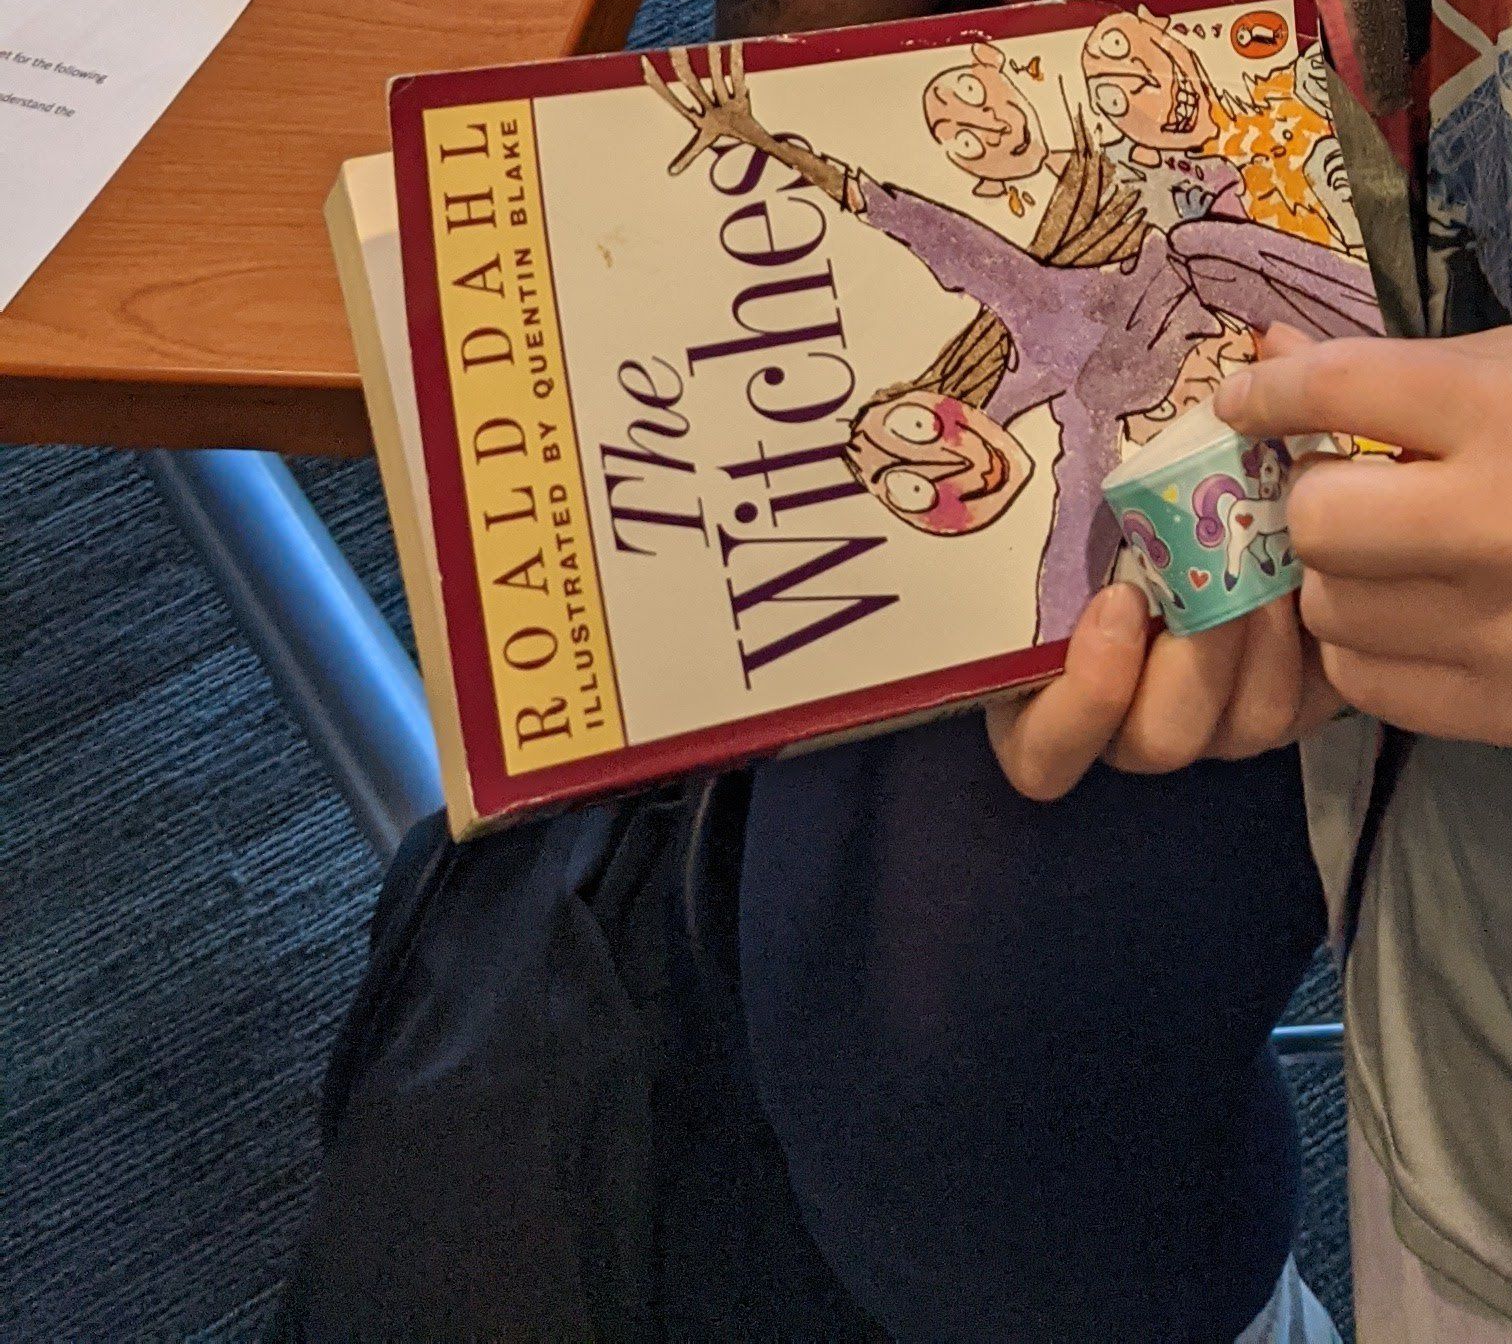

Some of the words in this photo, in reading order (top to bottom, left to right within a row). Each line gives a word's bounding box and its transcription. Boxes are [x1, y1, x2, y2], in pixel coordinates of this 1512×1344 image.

[13, 52, 32, 63] for
[32, 58, 53, 70] the
[54, 62, 108, 84] following
[55, 106, 75, 117] the
[439, 122, 515, 374] DAHL
[501, 118, 528, 228] BLAKE
[514, 248, 555, 400] QUENTIN
[686, 132, 901, 691] Witches
[537, 420, 562, 464] BY
[599, 356, 710, 557] The
[473, 417, 573, 750] ROALD
[549, 483, 606, 730] ILLUSTRATED
